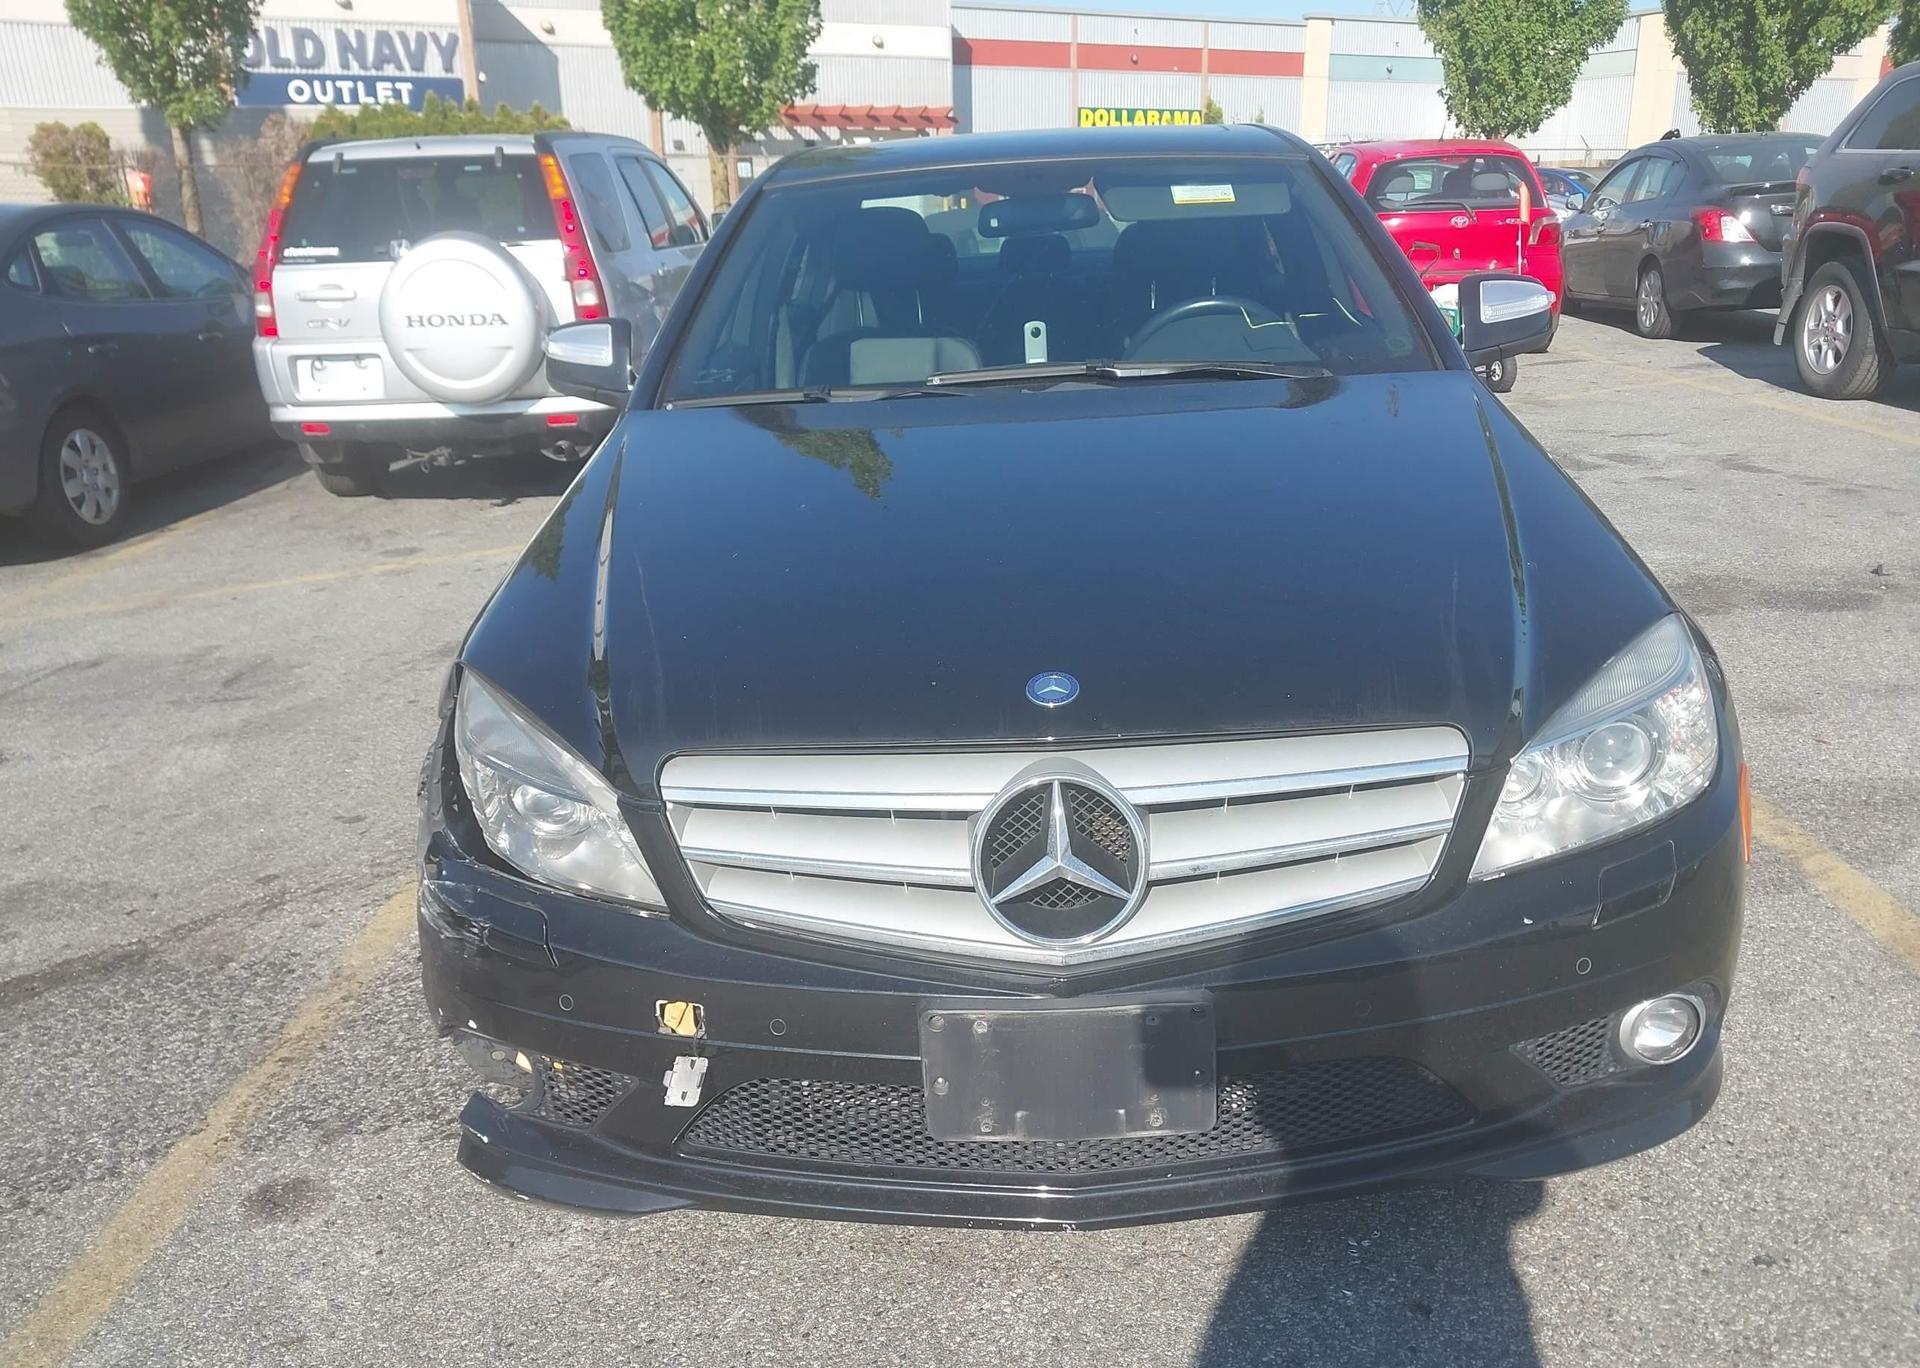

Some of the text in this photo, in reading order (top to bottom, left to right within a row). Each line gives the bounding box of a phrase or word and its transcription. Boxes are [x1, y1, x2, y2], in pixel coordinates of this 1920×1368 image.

[335, 28, 459, 73] NAVY
[287, 79, 413, 105] OUTLET
[1080, 108, 1201, 128] DOLLARAMA
[406, 313, 509, 328] HONDA
